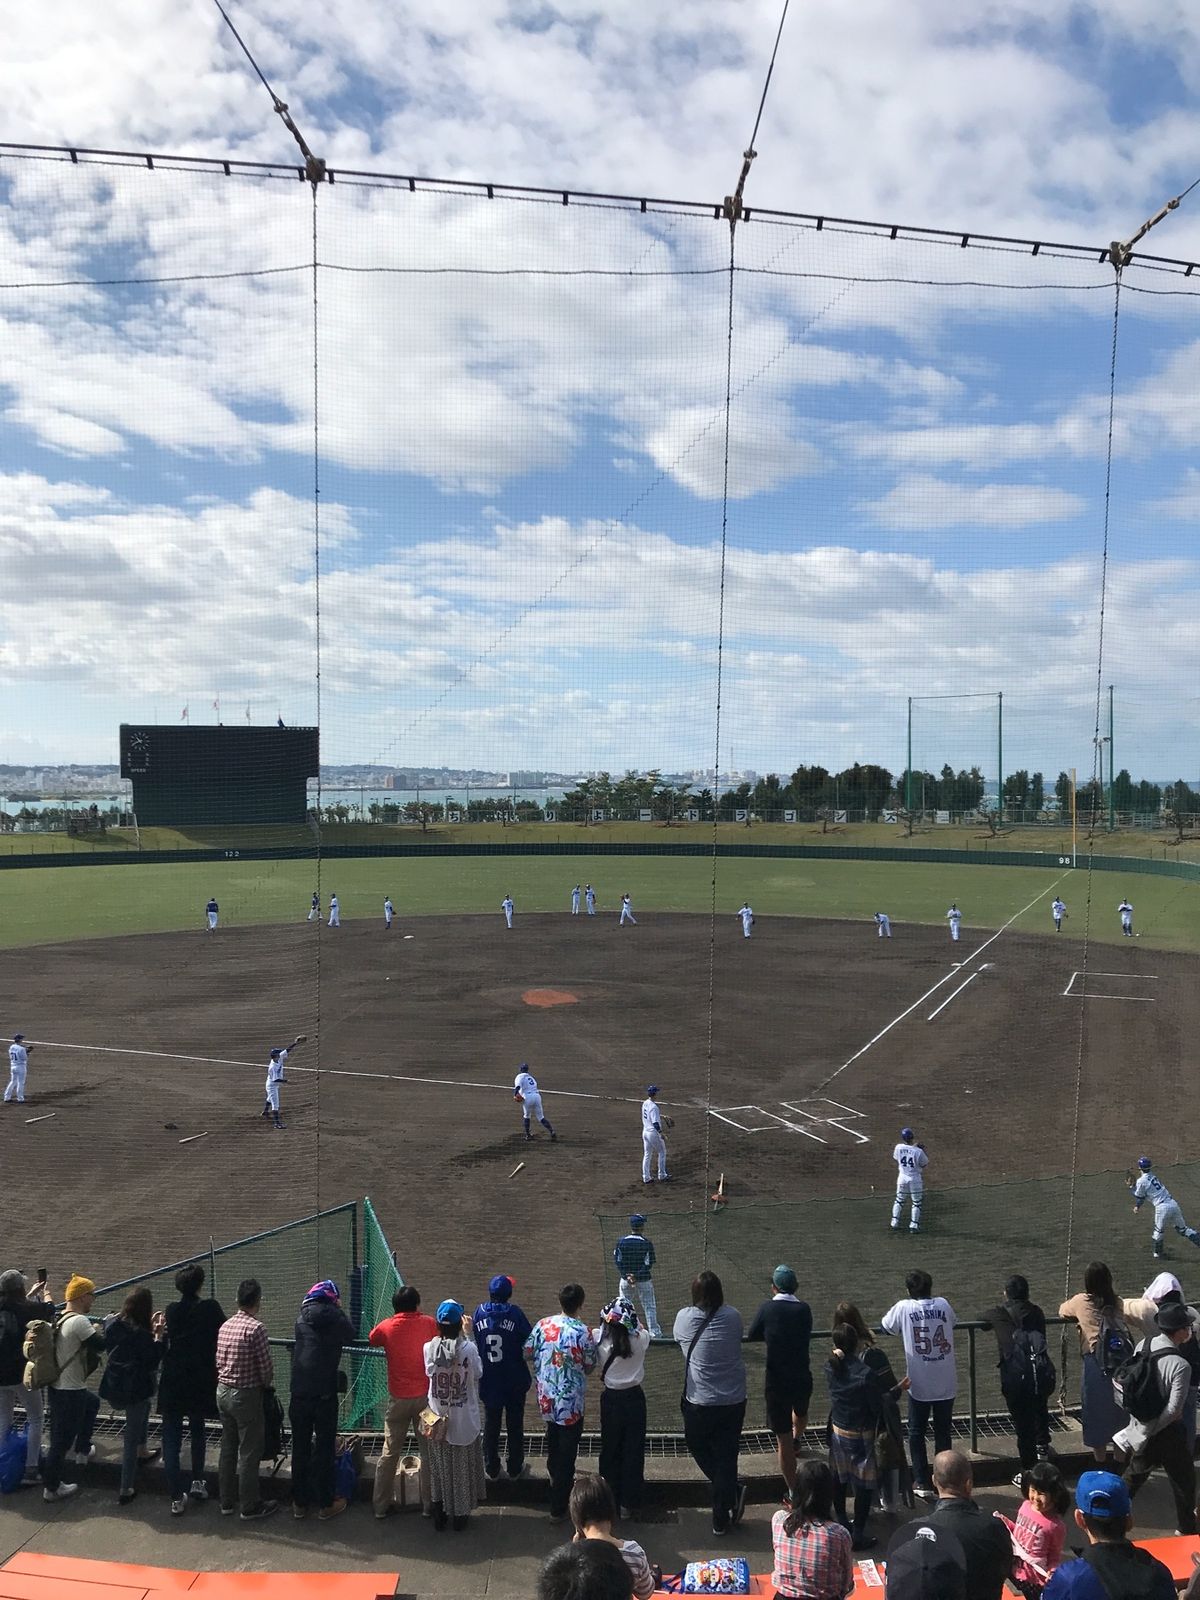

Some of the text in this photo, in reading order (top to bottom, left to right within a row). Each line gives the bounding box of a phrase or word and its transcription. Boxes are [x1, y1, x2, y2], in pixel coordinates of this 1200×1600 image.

[1058, 857, 1071, 865] 98
[900, 1155, 915, 1168] 44
[485, 1334, 503, 1363] 3
[913, 1325, 946, 1355] 54
